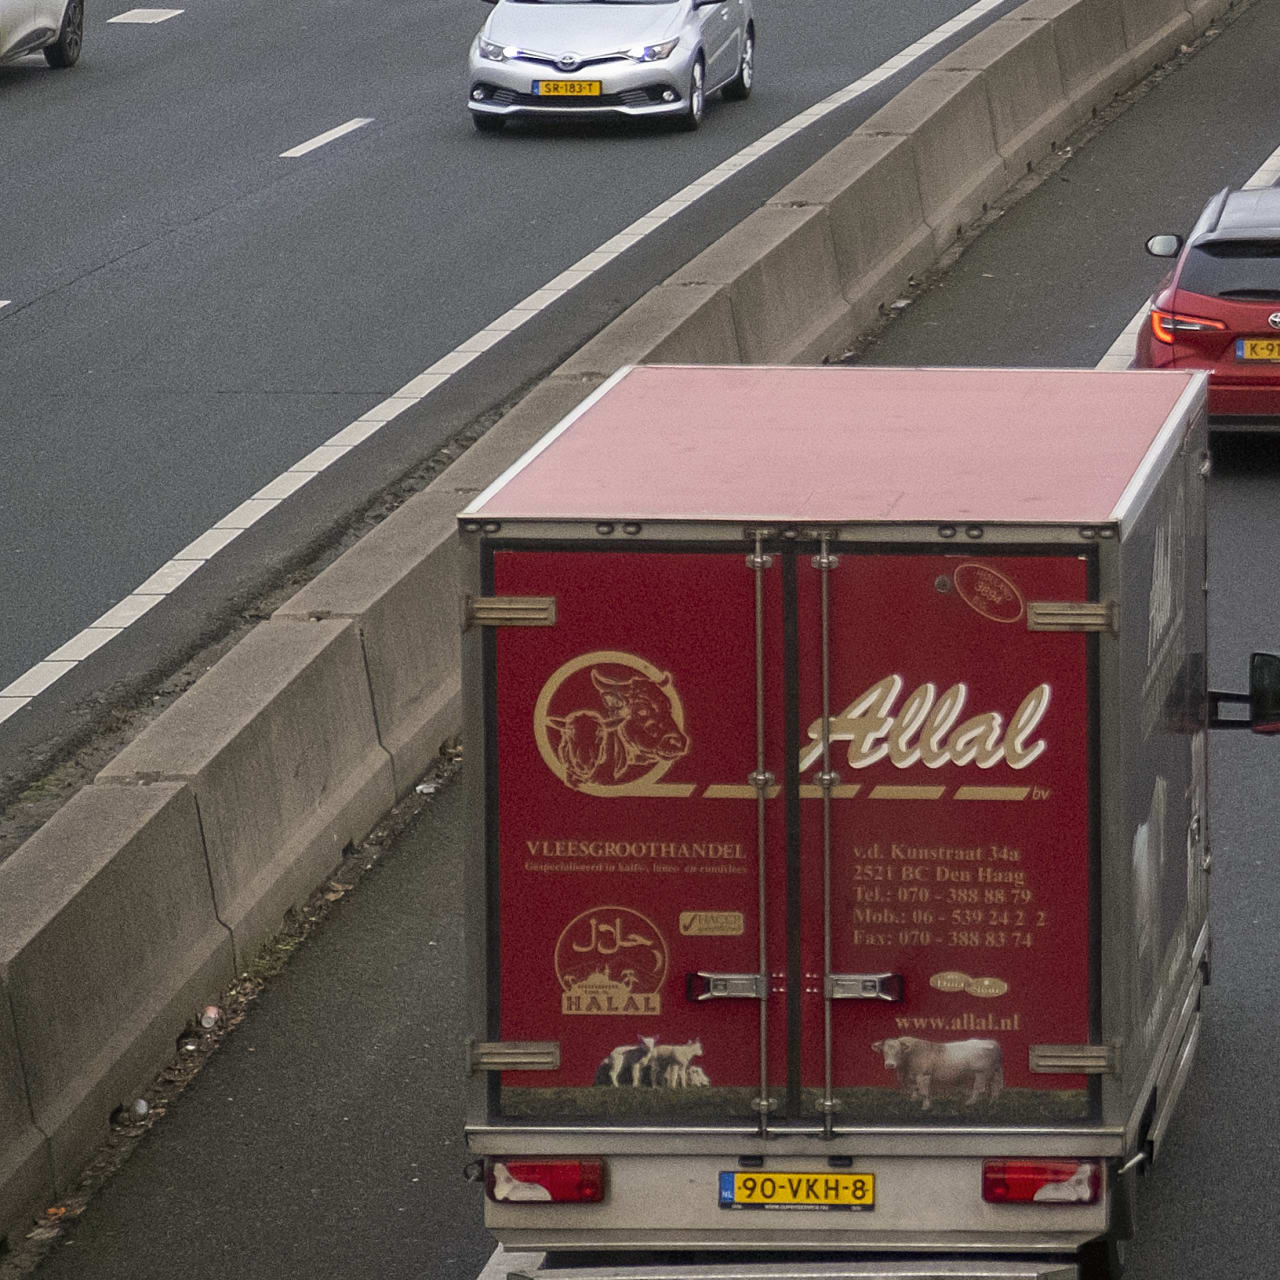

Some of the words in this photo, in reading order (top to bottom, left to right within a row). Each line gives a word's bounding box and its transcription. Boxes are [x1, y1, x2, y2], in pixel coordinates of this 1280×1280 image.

[544, 83, 593, 93] SR-183-T
[798, 674, 1051, 770] Allal
[1032, 785, 1050, 801] bv
[526, 841, 747, 859] VLEESGROOTHANDEL
[854, 843, 884, 859] v.d.
[891, 844, 983, 861] Kunstraat
[989, 846, 1020, 861] 34a
[853, 865, 893, 880] 2521
[901, 866, 928, 881] BC
[936, 866, 971, 882] Den
[978, 867, 1025, 887] Haag
[853, 887, 891, 902] Tel.:
[899, 888, 930, 902] 070
[947, 888, 979, 903] 388
[984, 889, 1006, 903] 88
[1011, 889, 1032, 904] 79
[853, 908, 906, 924] Mob.:
[912, 910, 933, 924] 06
[951, 910, 983, 925] 539
[988, 911, 1009, 926] 24
[572, 917, 654, 955] حلال
[853, 930, 892, 945] Fax:
[899, 931, 931, 946] 070
[948, 931, 980, 946] 388
[985, 932, 1006, 946] 83
[1011, 932, 1032, 947] 74
[566, 996, 656, 1012] HALAL
[895, 1013, 1020, 1031] www.allal.nl
[742, 1177, 866, 1200] 90-VKH-8
